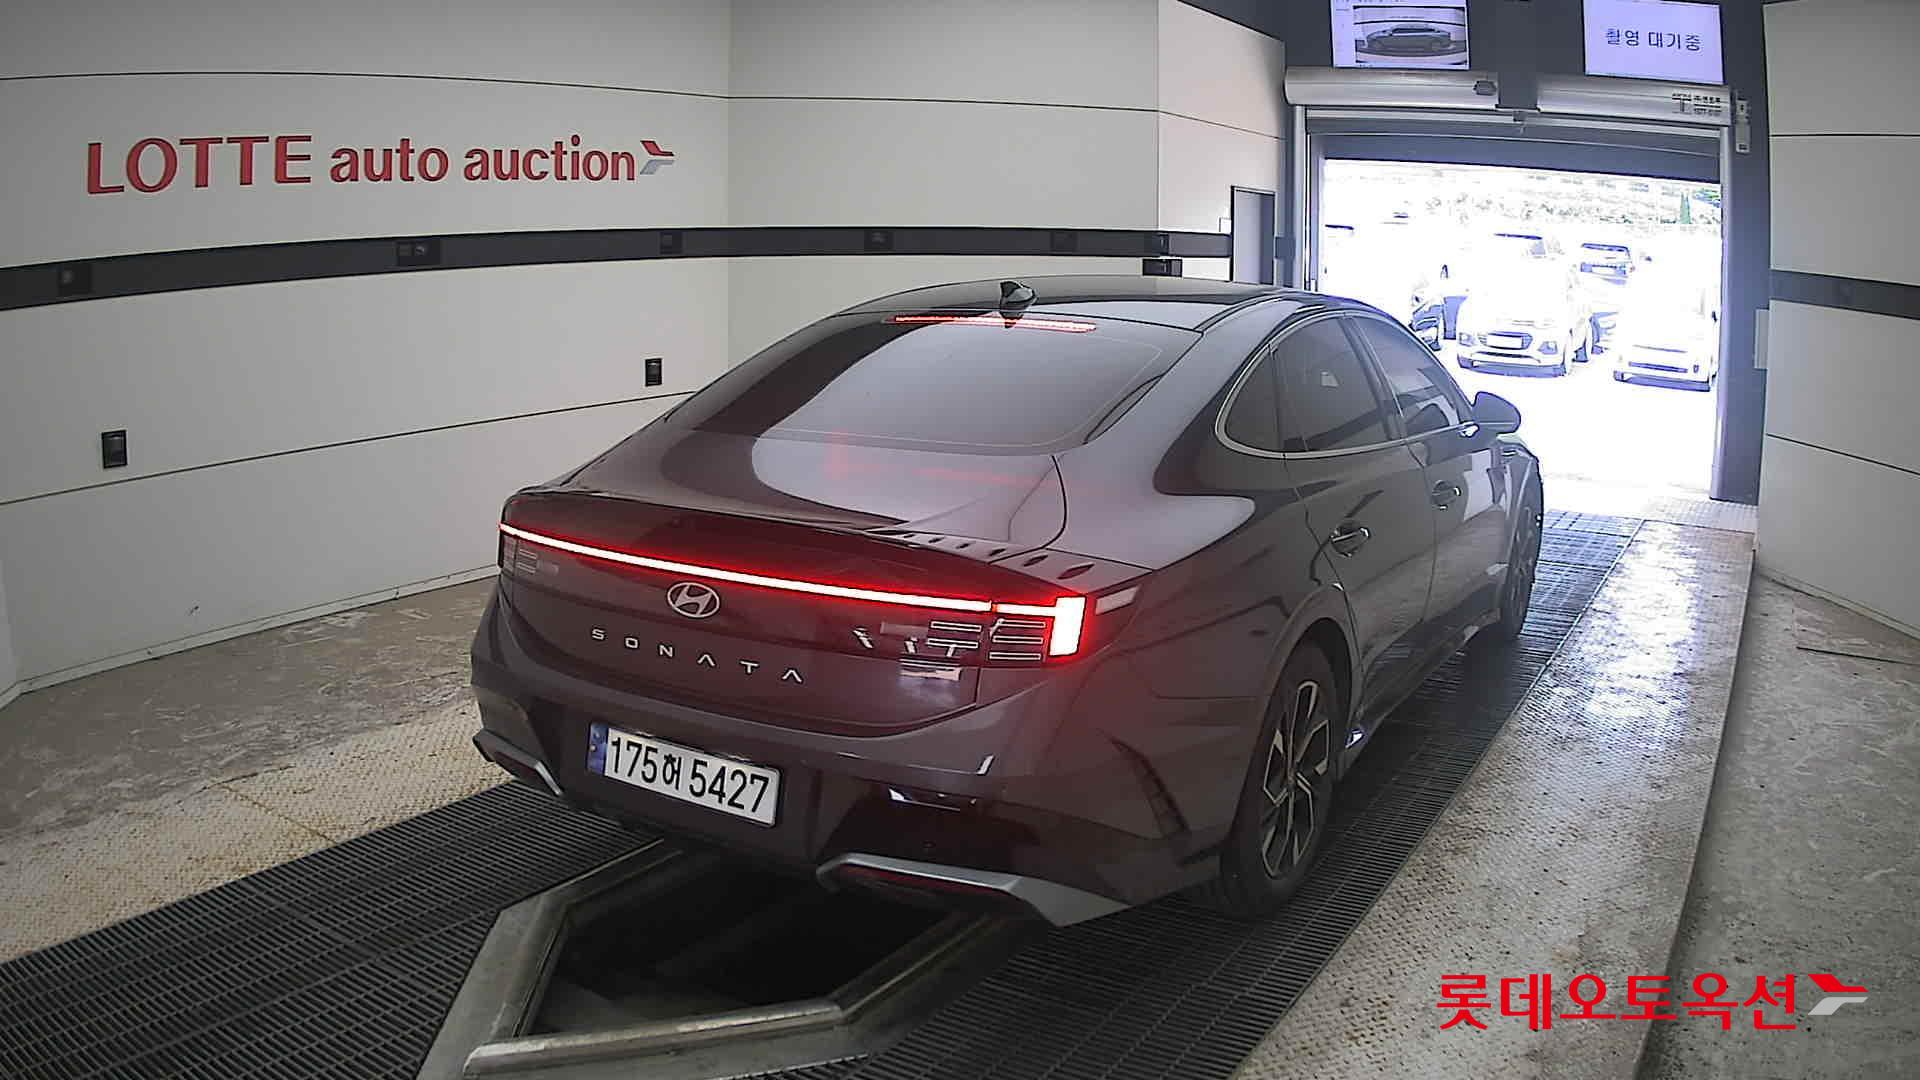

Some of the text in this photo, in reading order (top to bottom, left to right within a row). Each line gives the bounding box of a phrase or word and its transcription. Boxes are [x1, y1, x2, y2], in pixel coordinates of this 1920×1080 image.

[87, 134, 637, 195] LOTTE auto auction
[591, 628, 803, 683] SONATA
